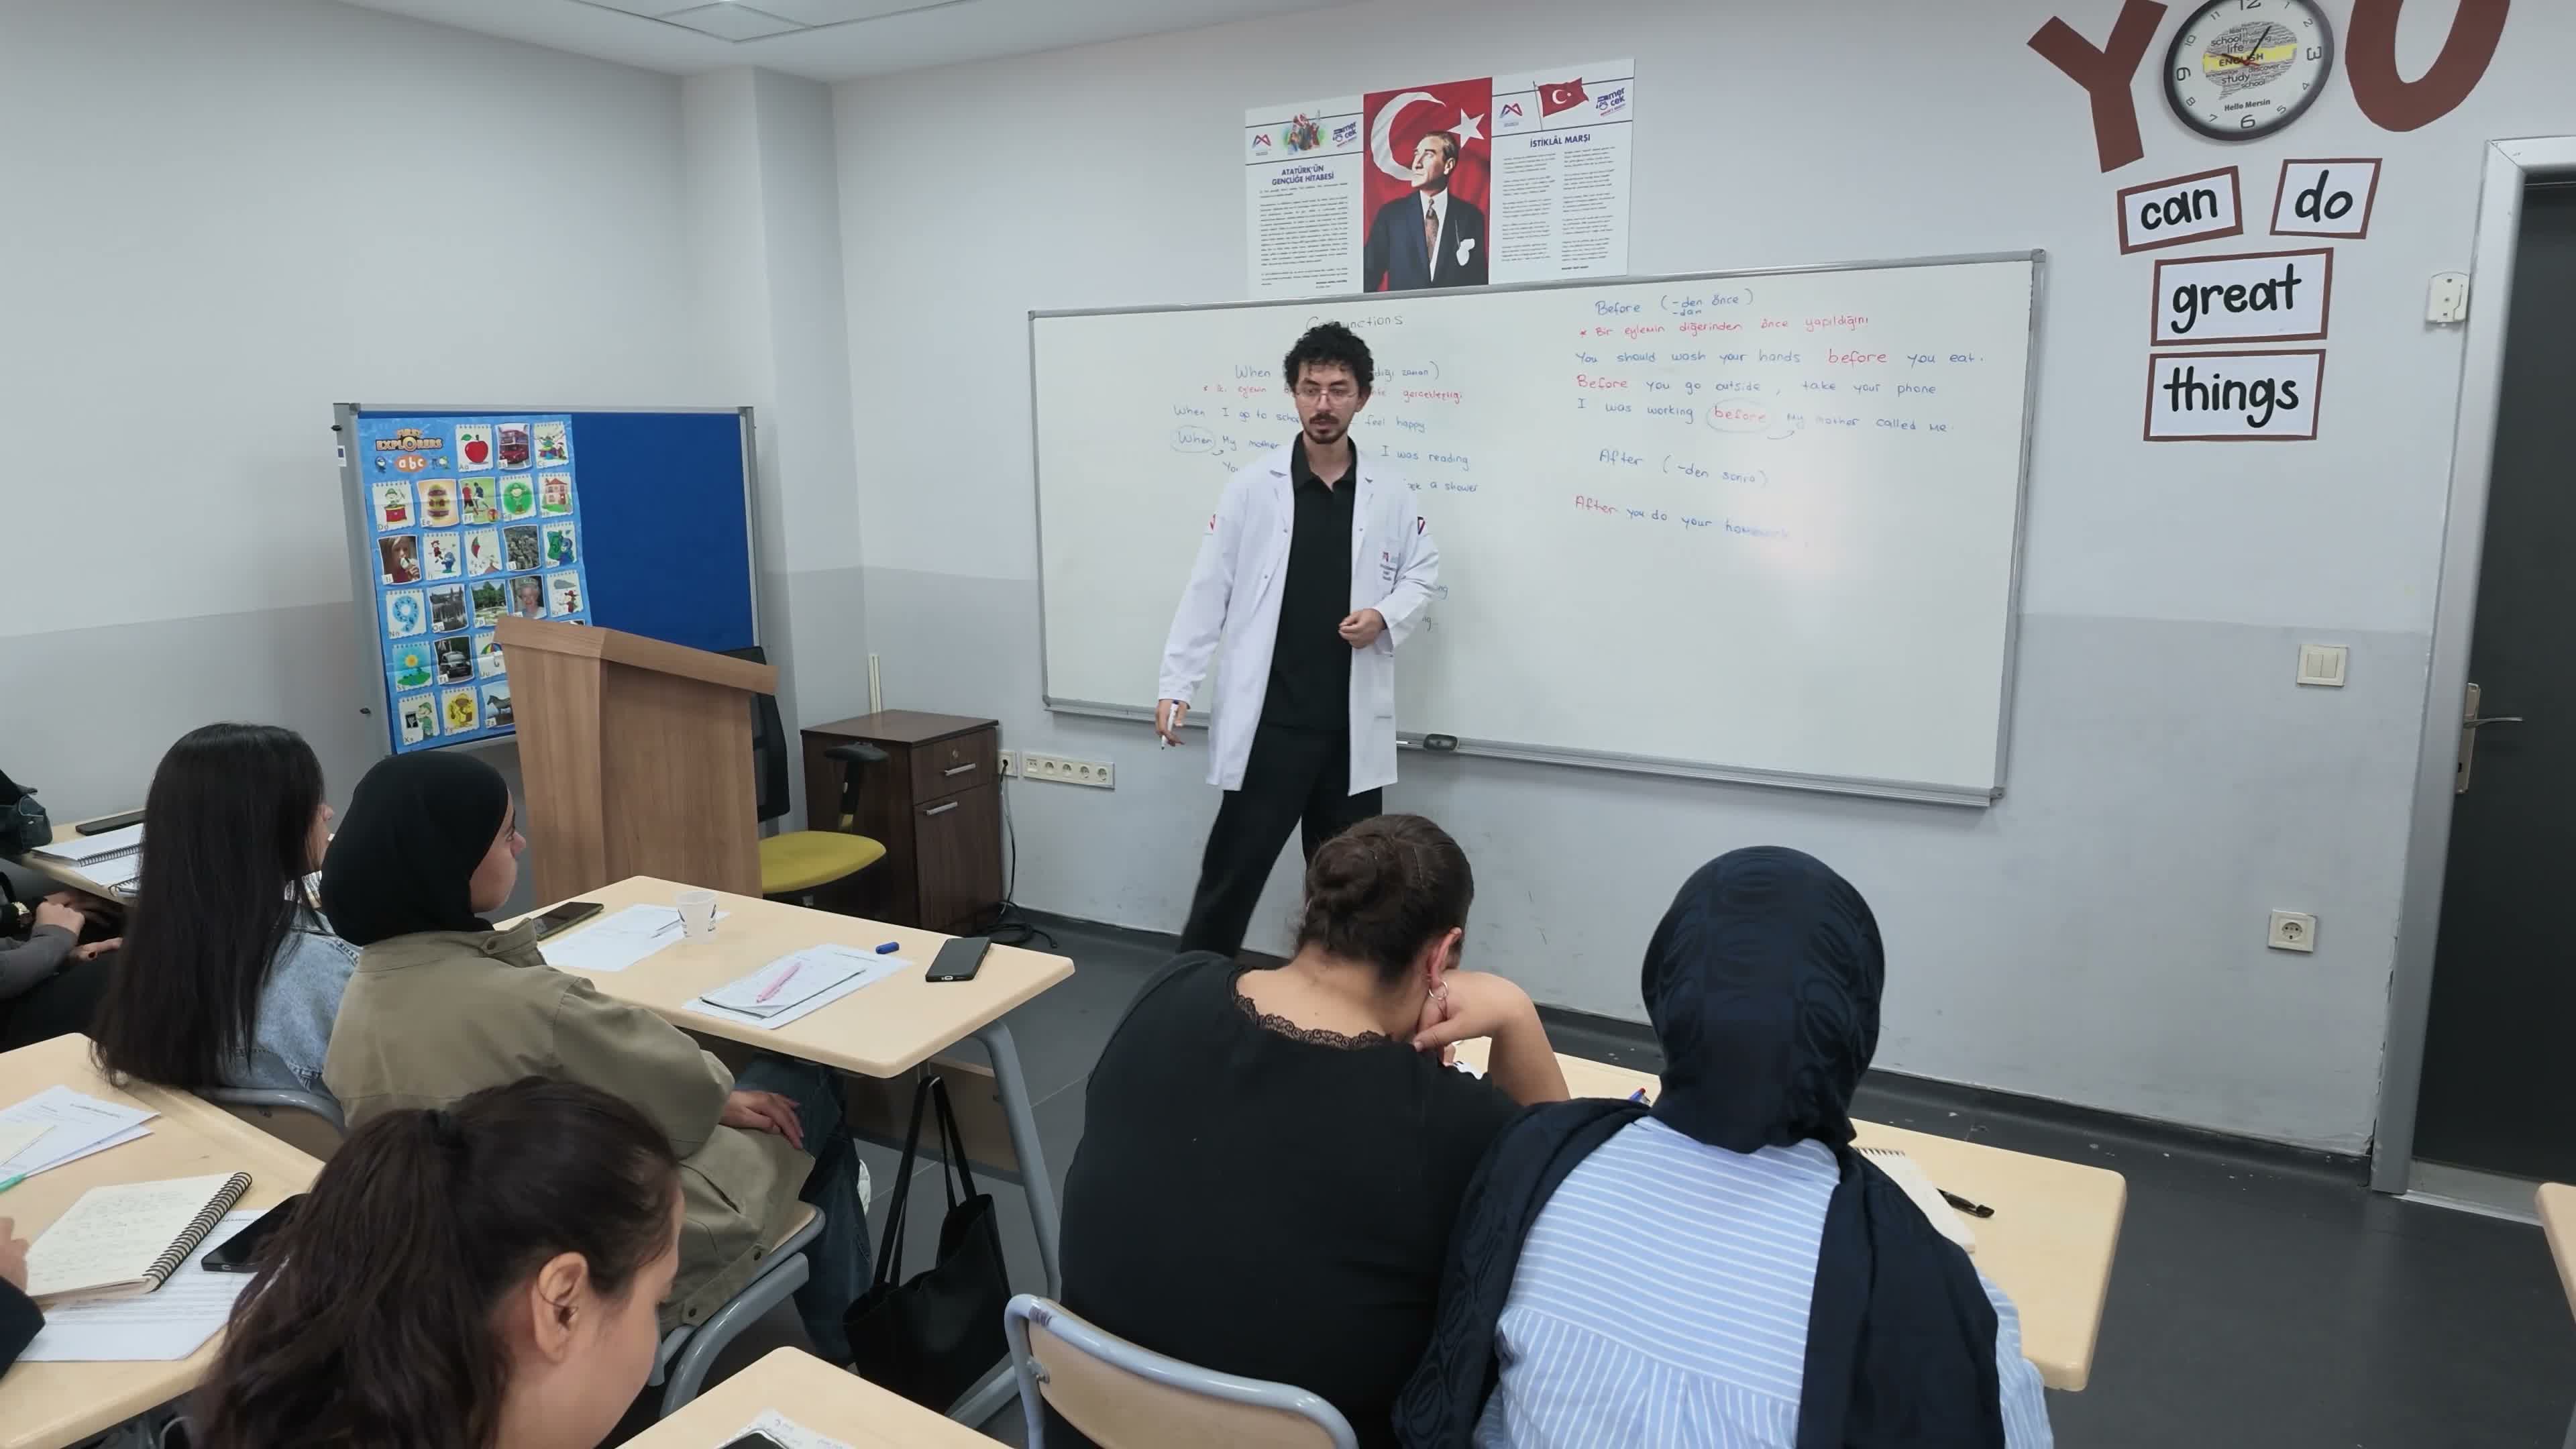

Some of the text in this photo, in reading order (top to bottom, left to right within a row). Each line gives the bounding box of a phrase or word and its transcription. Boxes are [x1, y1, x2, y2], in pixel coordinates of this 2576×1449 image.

[2303, 18, 2314, 28] 2
[2184, 35, 2196, 46] 10
[2211, 34, 2242, 46] school
[2227, 43, 2244, 53] life
[2306, 46, 2322, 60] 3
[2176, 67, 2192, 81] 9
[2222, 72, 2250, 84] study
[2241, 79, 2265, 89] school
[2186, 97, 2196, 106] 8
[2224, 99, 2271, 111] Hello Mersin
[2241, 115, 2255, 129] 6
[1564, 134, 1591, 145] MARŞI
[2141, 169, 2354, 231] can do
[2170, 263, 2302, 335] great
[1595, 301, 1642, 315] Before
[1595, 327, 1613, 337] Bir
[1624, 325, 1665, 339] eylemin
[1679, 322, 1742, 337] diğerinden
[1761, 319, 1788, 329] önce
[1576, 352, 1598, 364] You
[1617, 352, 1656, 362] should
[1672, 350, 1706, 361] wash
[1719, 353, 1746, 365] your
[1758, 349, 1801, 363] hands
[1829, 348, 1888, 368] before
[1908, 354, 1935, 369] you
[1235, 365, 1271, 379] When
[1576, 374, 1629, 389] Before
[1646, 382, 1670, 392] you
[1685, 382, 1702, 395] go
[1803, 380, 1836, 391] take
[1854, 383, 1881, 398] your
[1897, 382, 1936, 397] phone
[2163, 365, 2300, 429] things
[1173, 404, 1205, 417] When
[1222, 407, 1229, 417] I
[1239, 411, 1250, 423] go
[1256, 408, 1267, 419] to
[1365, 414, 1385, 426] feel
[1396, 416, 1425, 433] happy
[1578, 398, 1587, 409] I
[1605, 402, 1632, 413] was
[1648, 405, 1694, 425] working
[1715, 405, 1766, 421] before
[1876, 418, 1917, 431] called
[1178, 431, 1212, 446] When
[1248, 440, 1281, 450] mother
[1381, 445, 1389, 456] I
[1397, 451, 1418, 460] was
[1429, 453, 1469, 472] reading
[1600, 449, 1643, 464] After
[1444, 480, 1478, 492] shower
[1576, 496, 1617, 515] After
[1627, 507, 1644, 520] you
[1652, 510, 1667, 521] do
[1681, 517, 1712, 530] your
